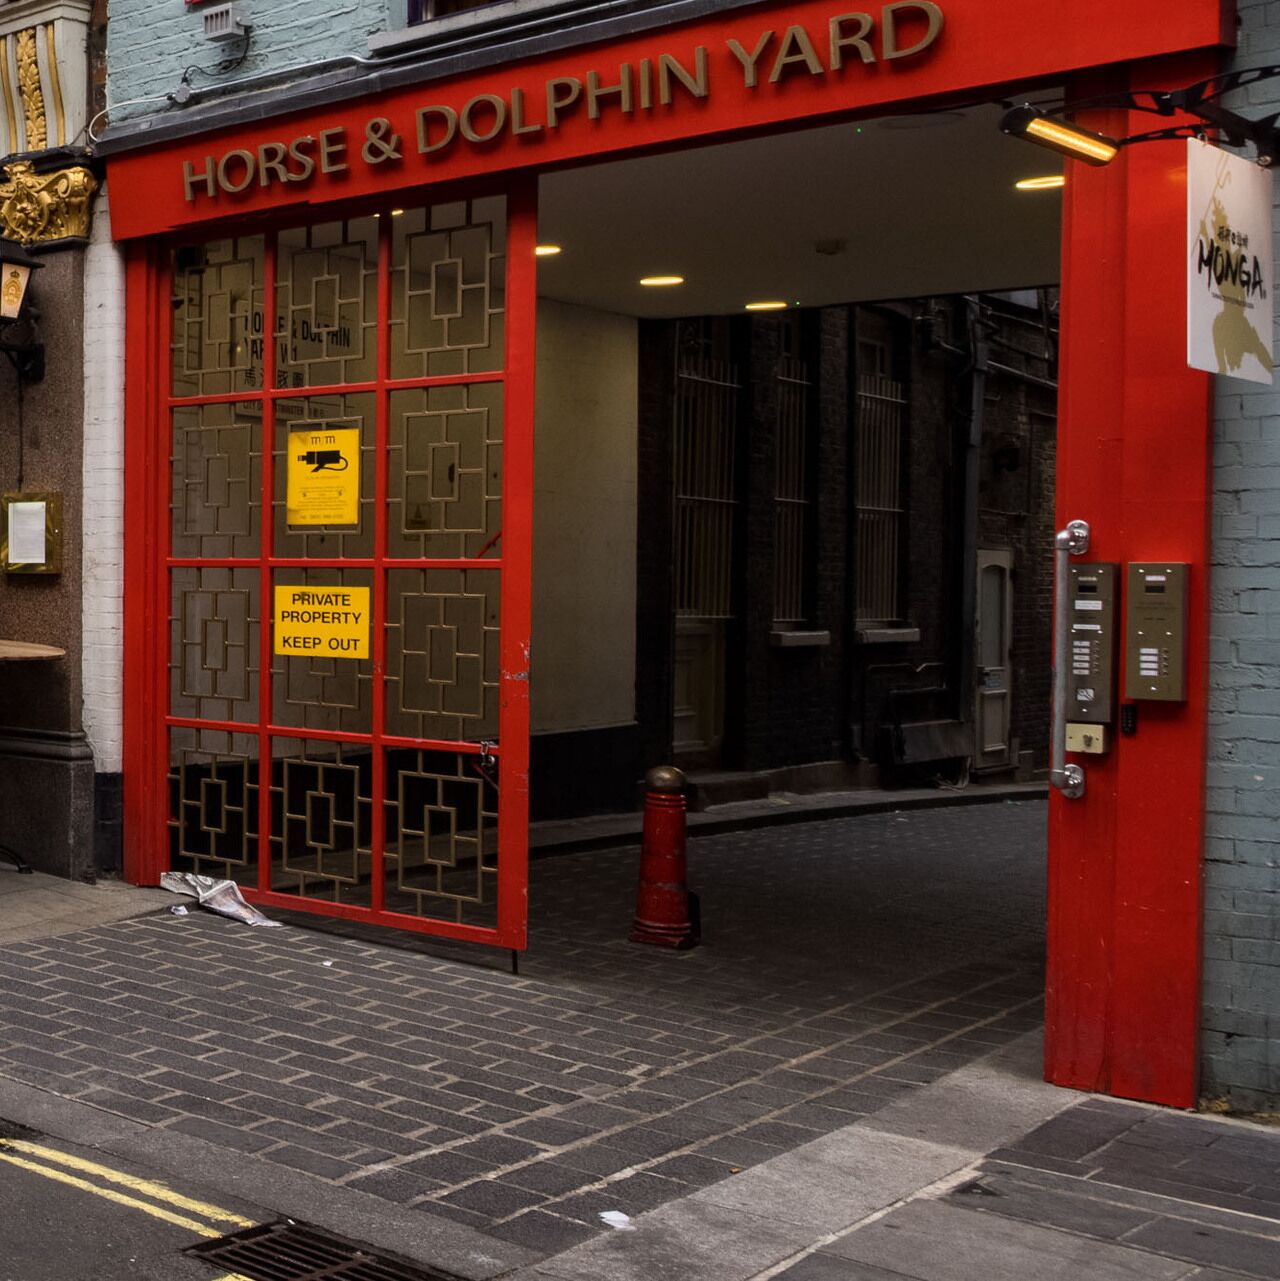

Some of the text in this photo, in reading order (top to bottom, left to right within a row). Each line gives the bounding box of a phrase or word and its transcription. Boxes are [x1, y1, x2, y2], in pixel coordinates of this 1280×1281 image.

[183, 0, 944, 202] HORSE & DOLPHIN YARD
[1198, 238, 1264, 299] MONGA
[292, 593, 352, 607] PRIVATE
[281, 610, 362, 625] PROPERTY
[282, 636, 361, 651] KEEP OUT
